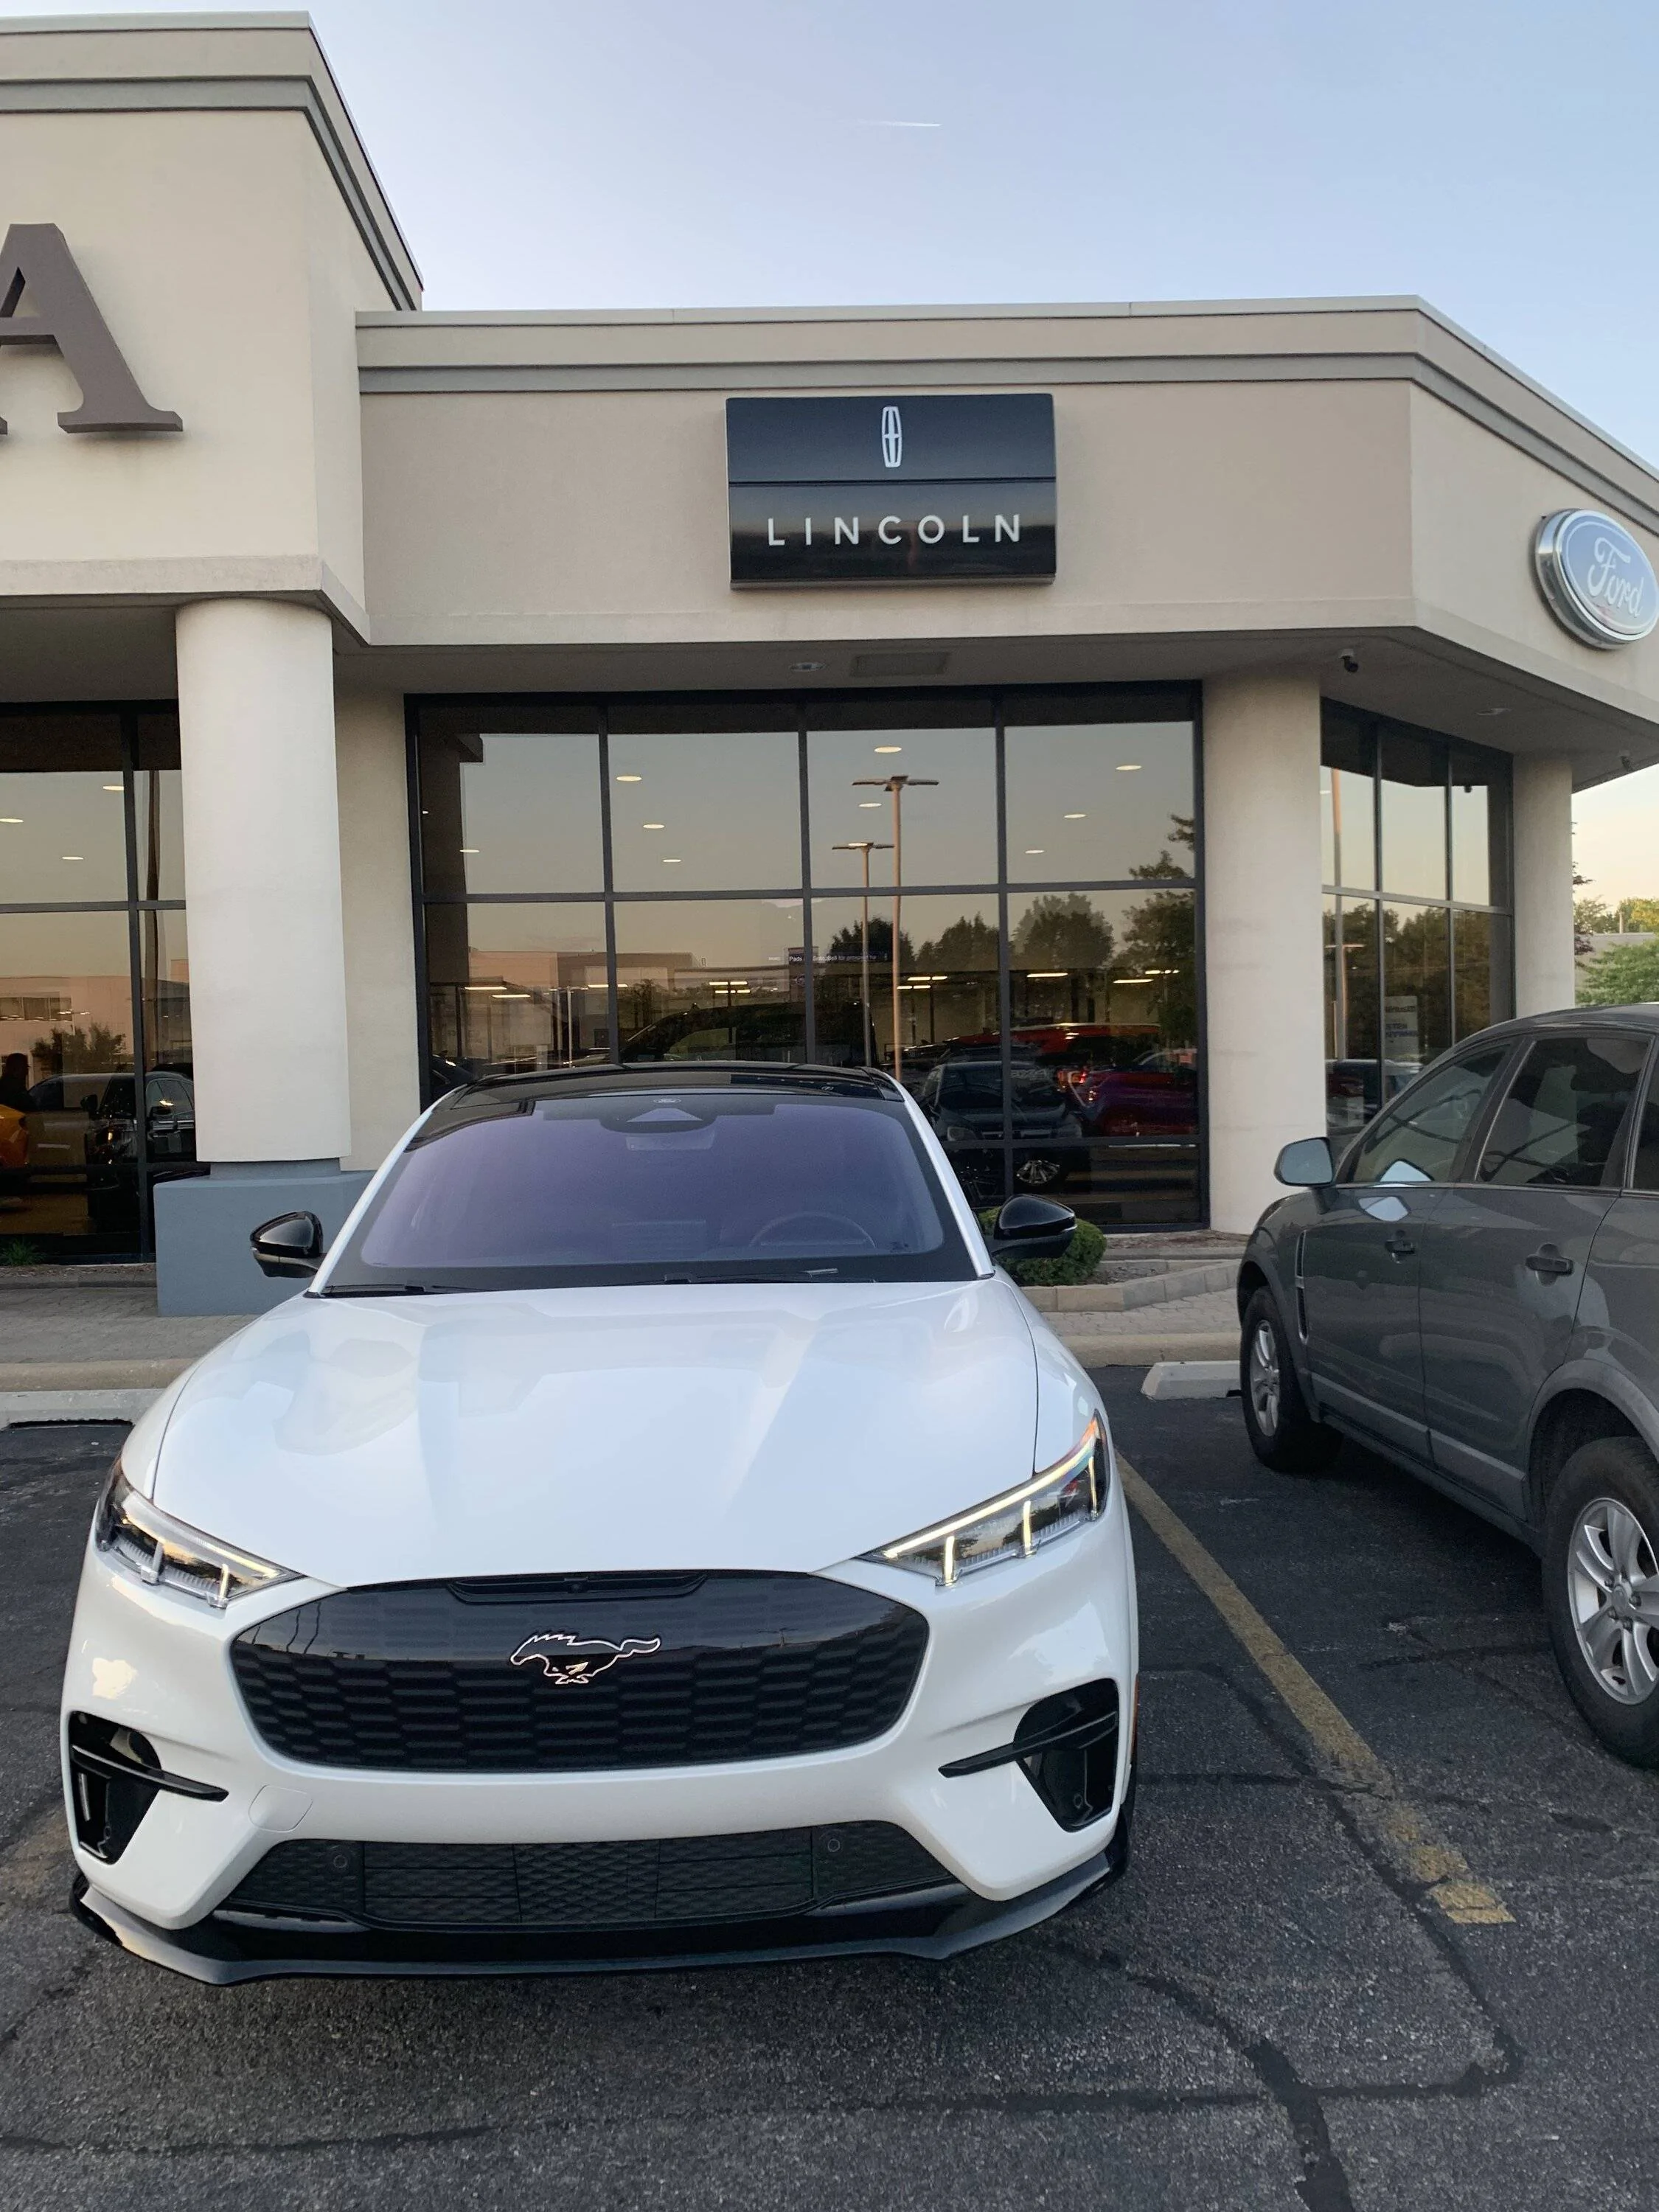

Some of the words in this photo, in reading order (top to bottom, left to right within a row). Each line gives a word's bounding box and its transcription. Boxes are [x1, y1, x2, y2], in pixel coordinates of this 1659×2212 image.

[0, 223, 183, 434] A
[768, 514, 1020, 546] LINCOLN
[1587, 537, 1644, 618] Ford
